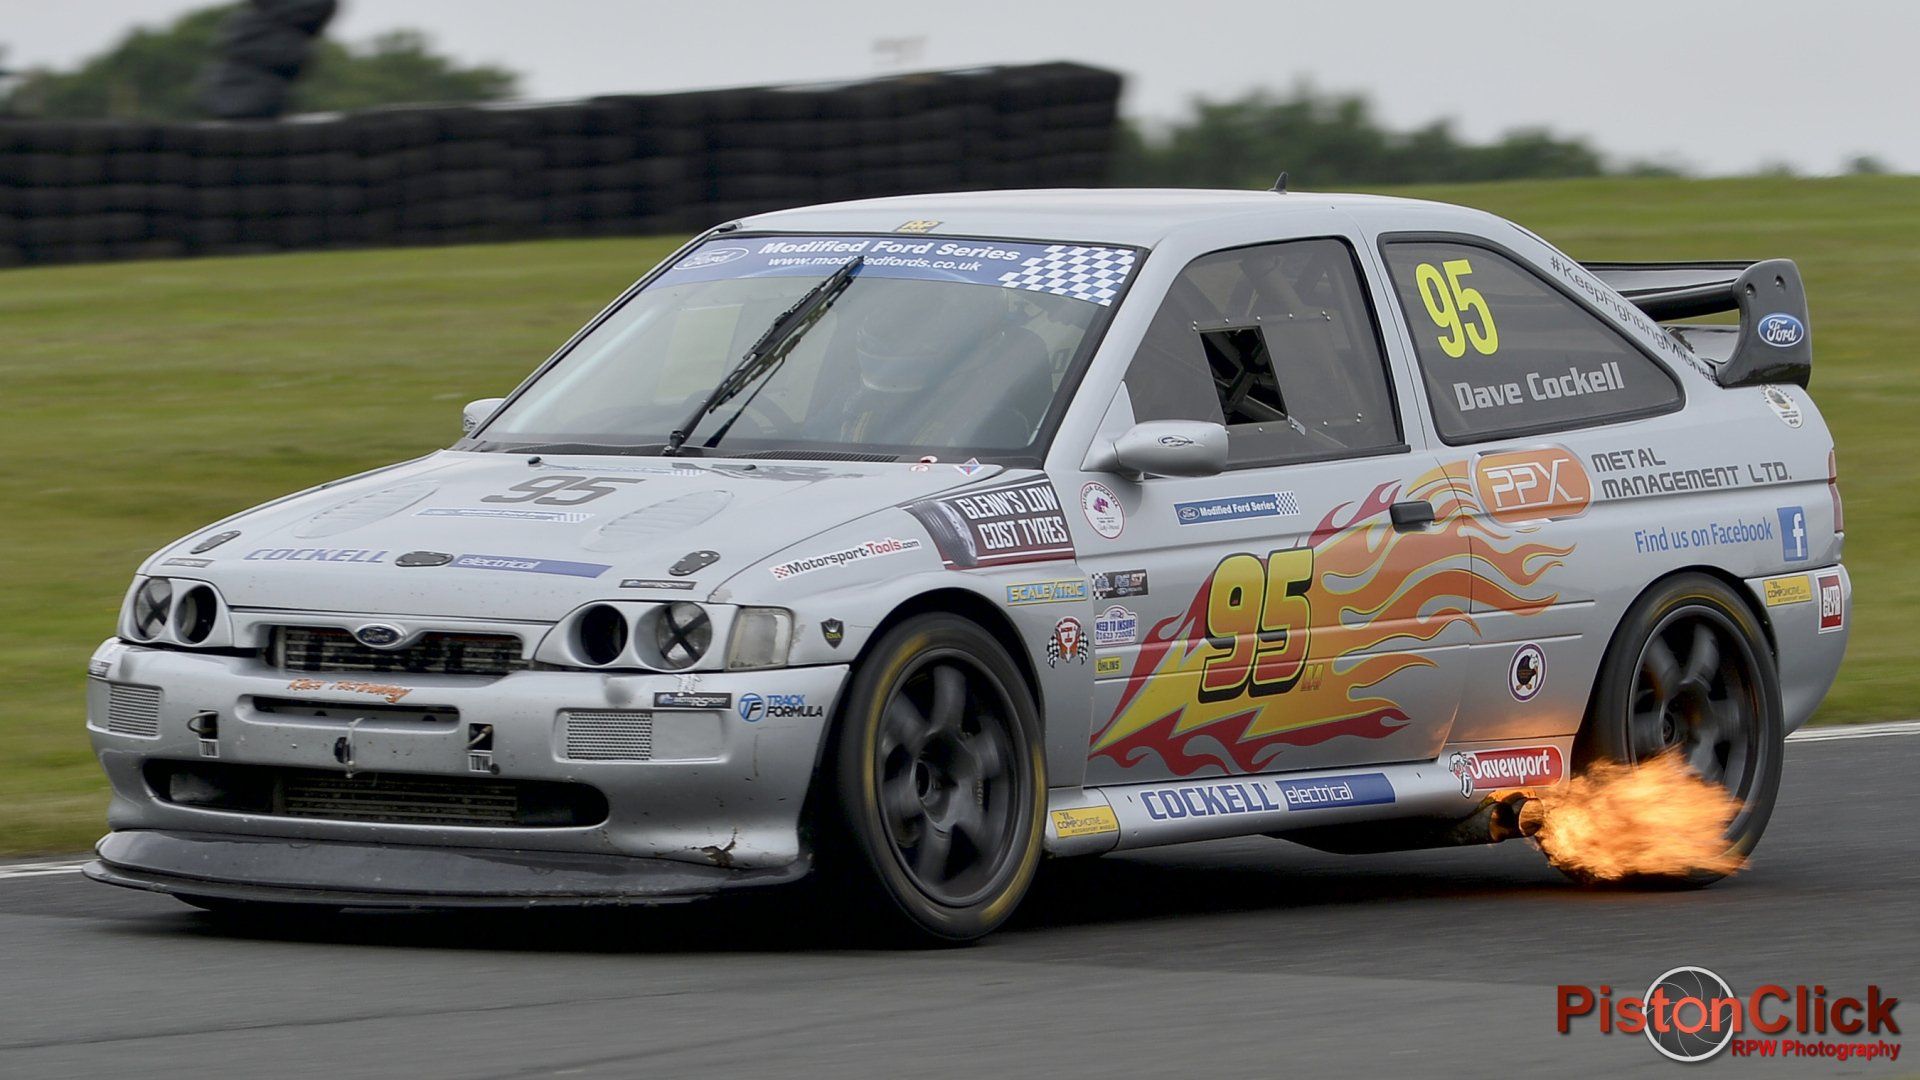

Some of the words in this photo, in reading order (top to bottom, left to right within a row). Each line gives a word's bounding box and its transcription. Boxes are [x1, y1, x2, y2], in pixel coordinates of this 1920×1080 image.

[758, 240, 870, 255] Modified
[870, 240, 936, 255] Ford
[936, 243, 1021, 261] Series
[1415, 258, 1499, 359] 95
[1766, 318, 1797, 342] Ford
[1453, 382, 1524, 412] Dave
[1526, 361, 1625, 402] Cockell
[1591, 447, 1666, 472] METAL
[480, 475, 646, 506] 95
[1482, 458, 1584, 512] PPX
[1601, 465, 1739, 499] MANAGEMENT
[1747, 461, 1792, 483] LTD.
[955, 493, 1025, 520] GLENN'S
[1018, 485, 1059, 515] LOW
[1200, 505, 1232, 517] Modified
[1232, 502, 1251, 513] Ford
[1251, 500, 1275, 511] Series
[977, 521, 1020, 550] COST
[1018, 515, 1069, 545] TYRES
[1634, 527, 1669, 553] Find
[1671, 530, 1689, 549] us
[1692, 528, 1709, 547] on
[1710, 516, 1773, 545] Facebook
[243, 548, 388, 563] COCKELL
[457, 555, 540, 570] electrical
[1096, 621, 1109, 632] NEED
[1117, 619, 1136, 631] INSURE
[1197, 546, 1314, 704] 95
[766, 694, 806, 705] TRACK
[766, 705, 823, 718] FORMULA
[1141, 782, 1279, 820] COCKELL
[1286, 781, 1353, 804] electrical
